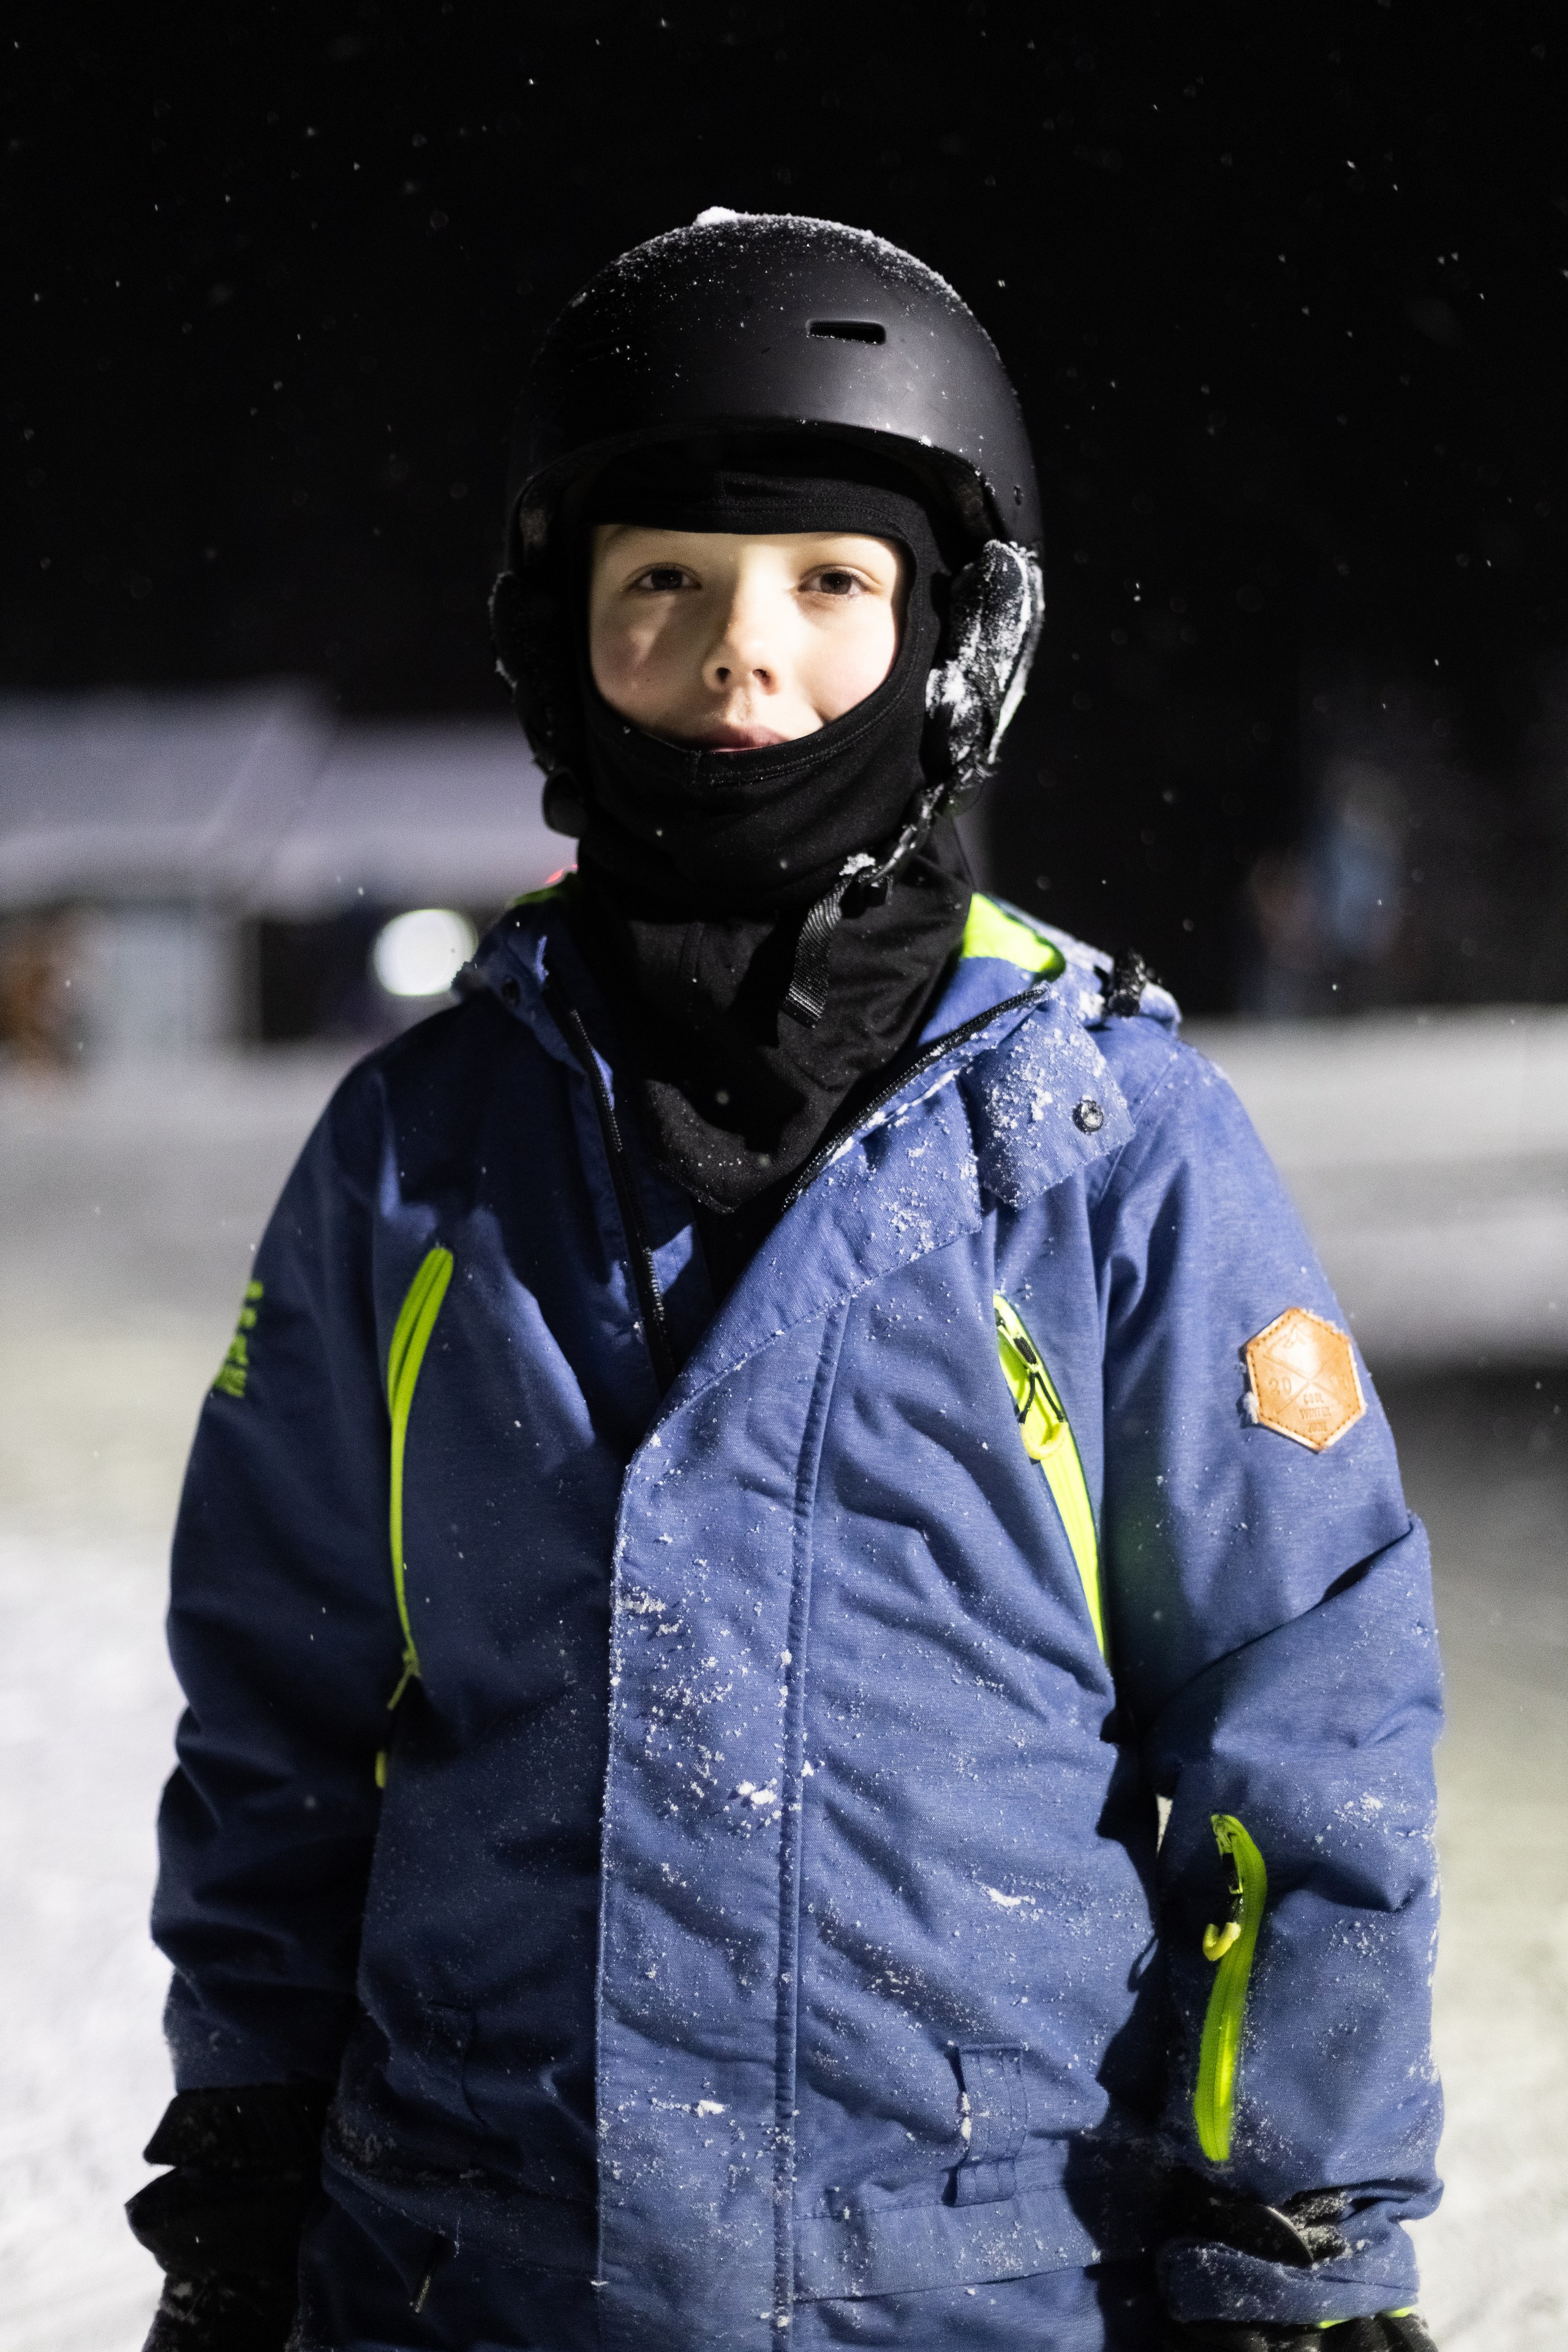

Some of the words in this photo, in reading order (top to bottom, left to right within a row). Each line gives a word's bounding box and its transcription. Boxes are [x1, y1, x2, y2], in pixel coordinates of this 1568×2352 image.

[1268, 1378, 1292, 1395] 20
[1303, 1392, 1324, 1404] COOL
[1299, 1406, 1331, 1419] WINTER
